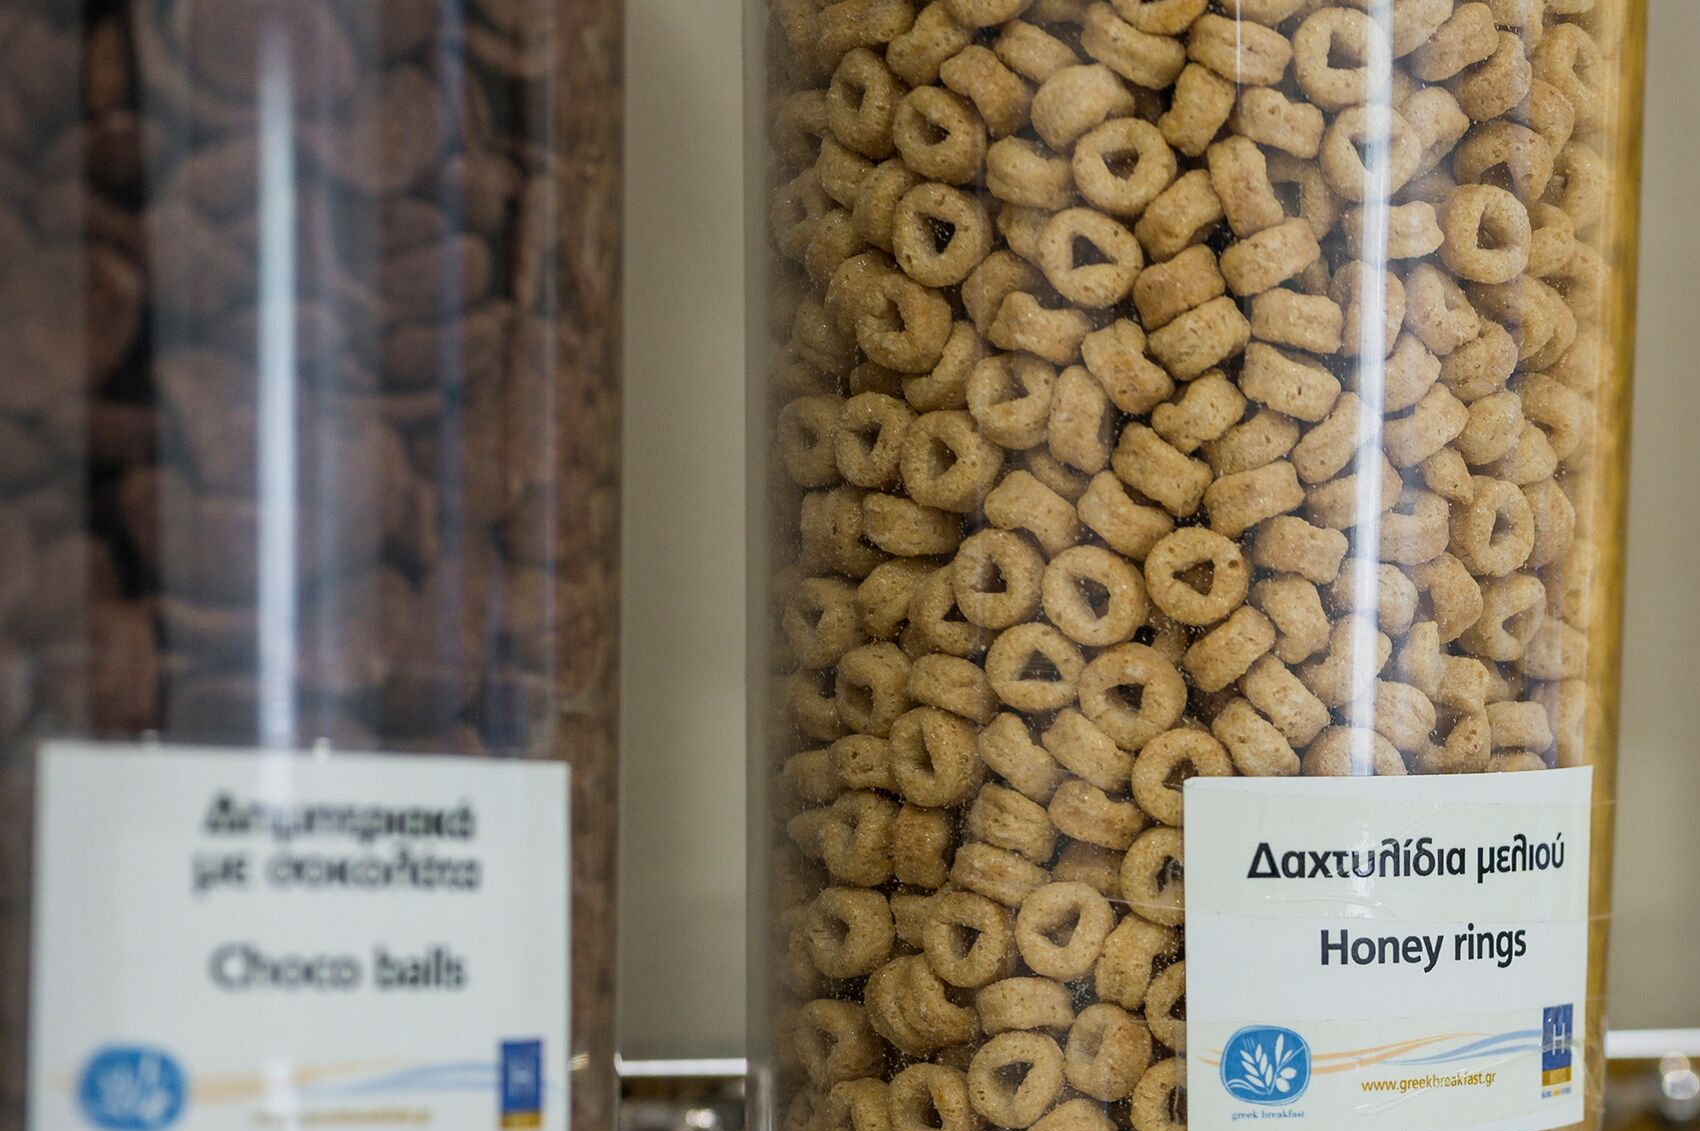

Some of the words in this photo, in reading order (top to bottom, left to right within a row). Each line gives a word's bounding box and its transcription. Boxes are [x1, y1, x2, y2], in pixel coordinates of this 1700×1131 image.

[1247, 837, 1466, 879] Δαχτυλίδια
[1477, 832, 1566, 884] μελιού
[210, 943, 363, 990] Choco
[374, 944, 468, 990] balls
[1320, 929, 1445, 973] Honey
[1454, 923, 1528, 968] rings
[1231, 1110, 1259, 1121] greek
[1261, 1110, 1305, 1119] breakfast
